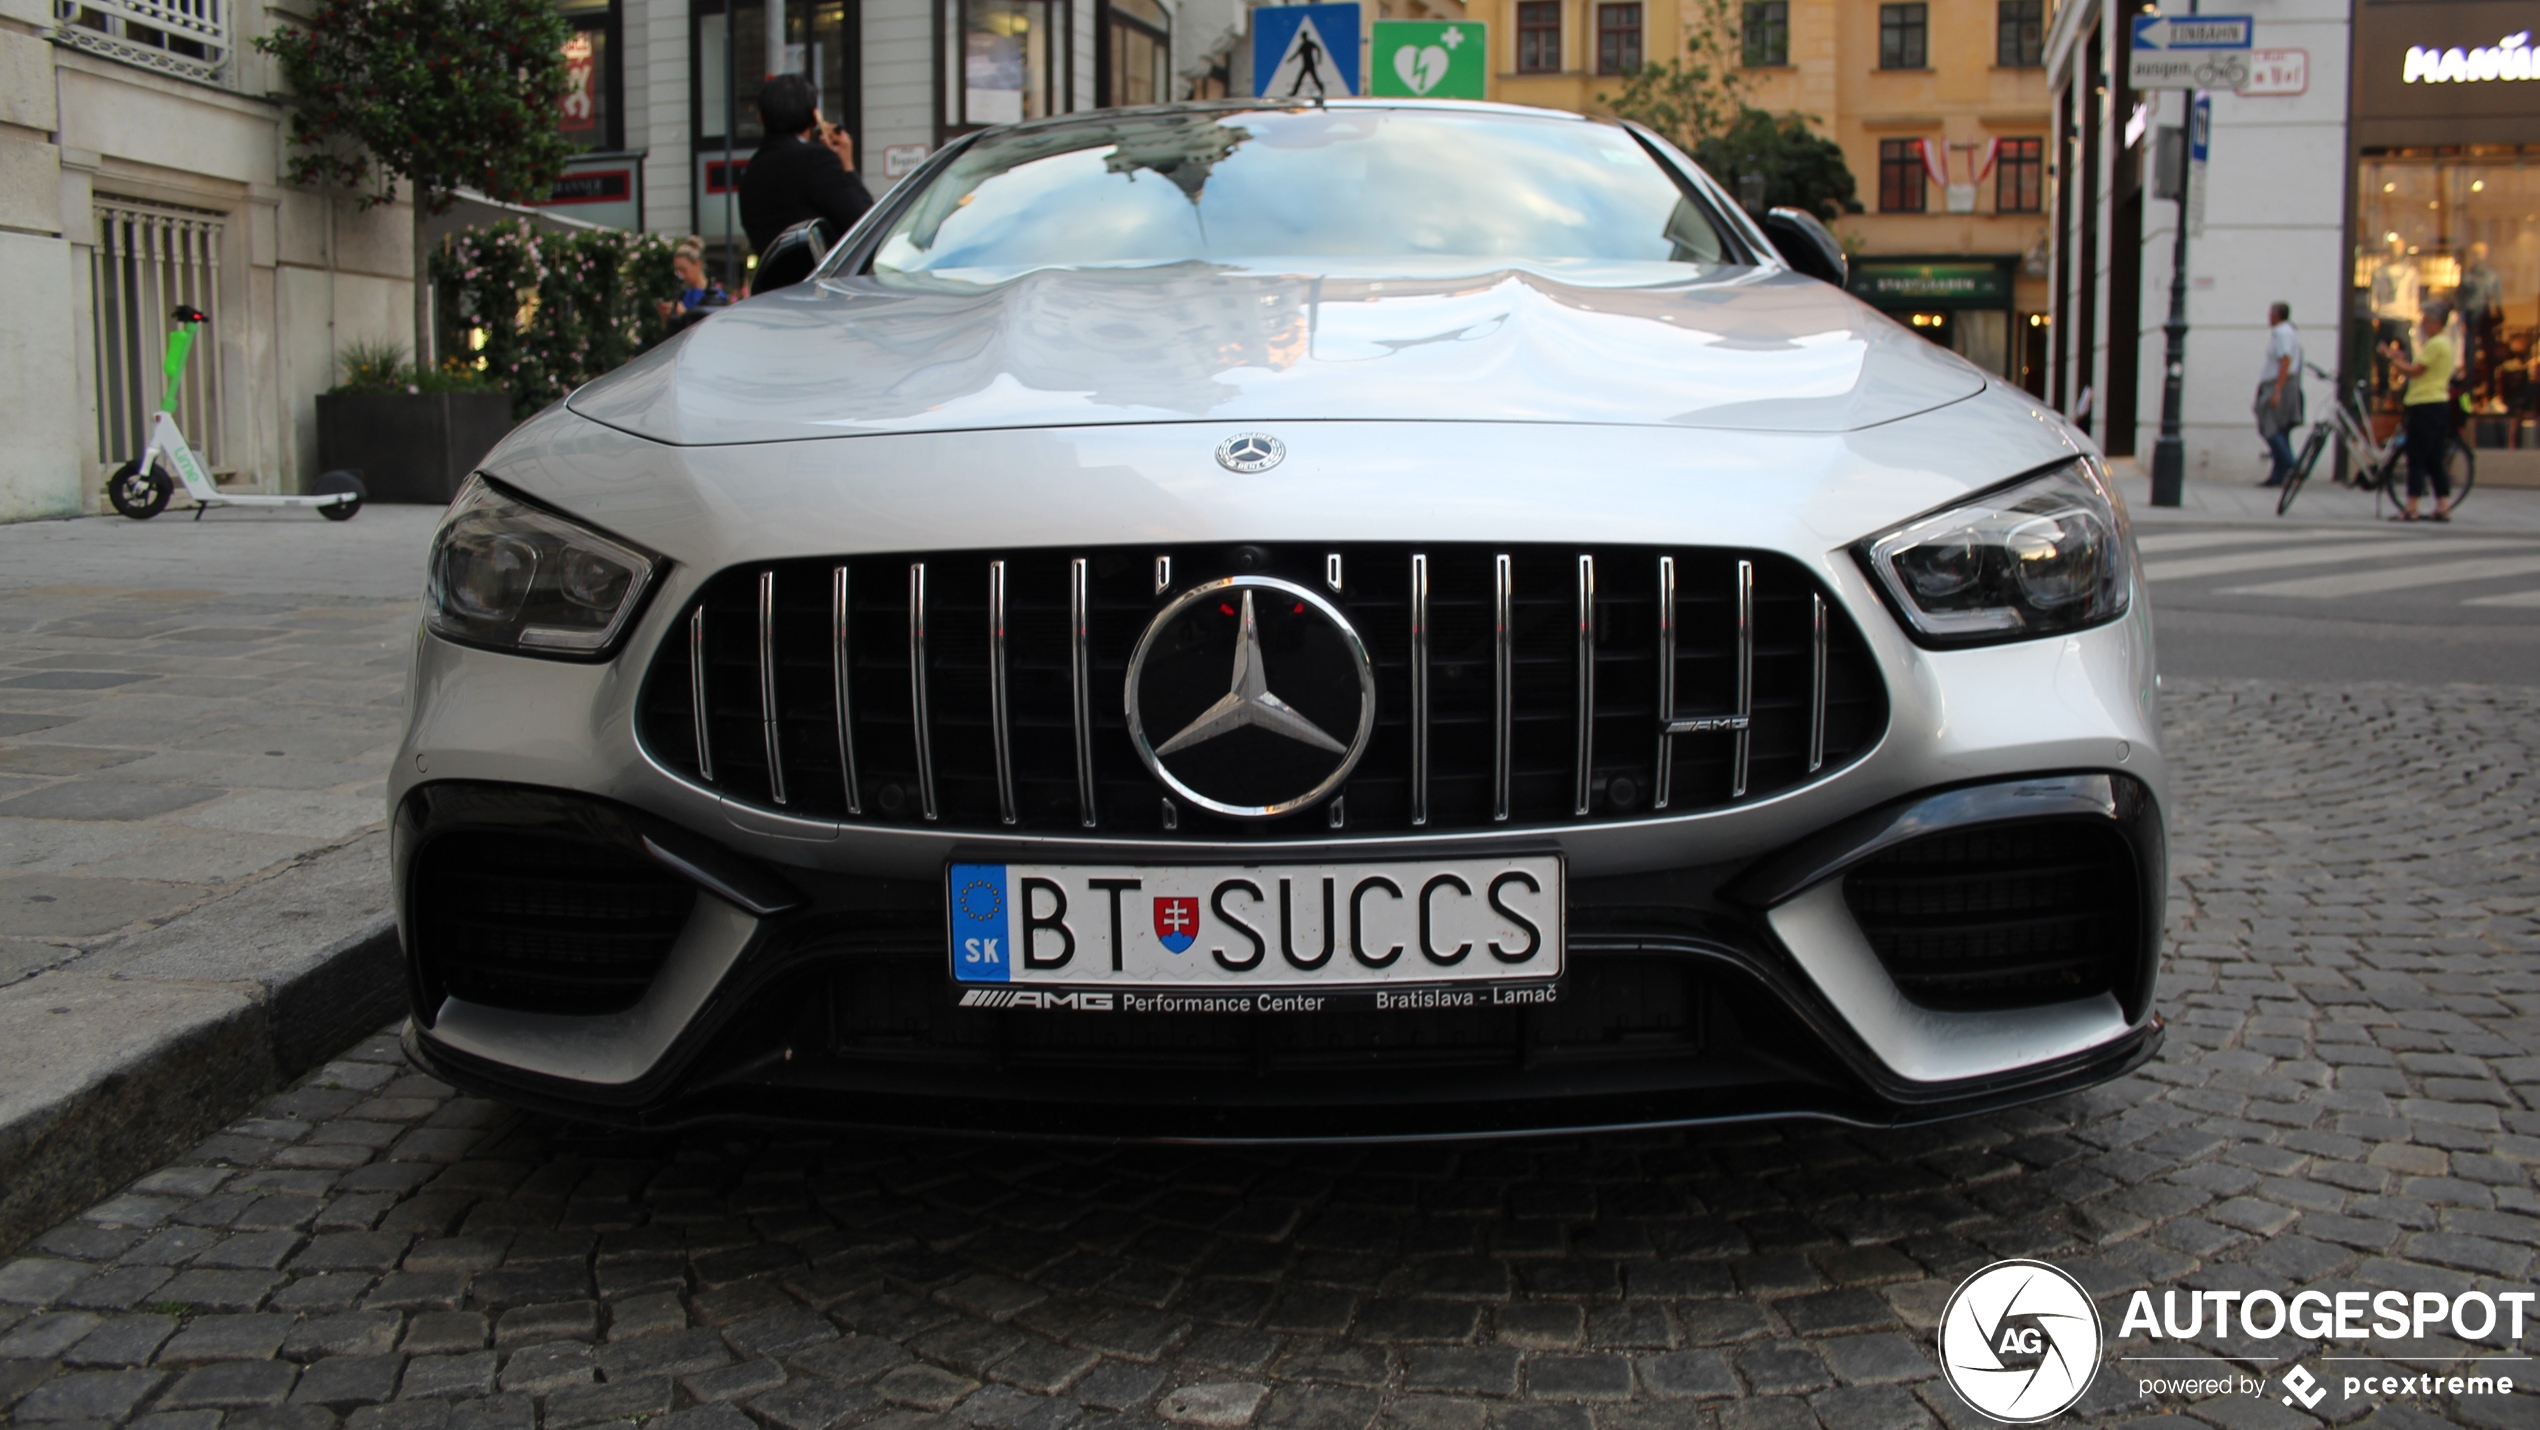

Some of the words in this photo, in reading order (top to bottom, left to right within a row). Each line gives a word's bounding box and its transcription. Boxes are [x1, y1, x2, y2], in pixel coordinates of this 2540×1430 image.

[2171, 24, 2238, 43] EINBAHN
[1021, 877, 1142, 971] BT
[1211, 871, 1542, 972] SUCCS
[965, 938, 999, 963] SK
[1123, 993, 1250, 1012] Performance
[1257, 992, 1325, 1012] Center
[1376, 989, 1474, 1010] Bratislava
[1493, 985, 1557, 1004] Lamač
